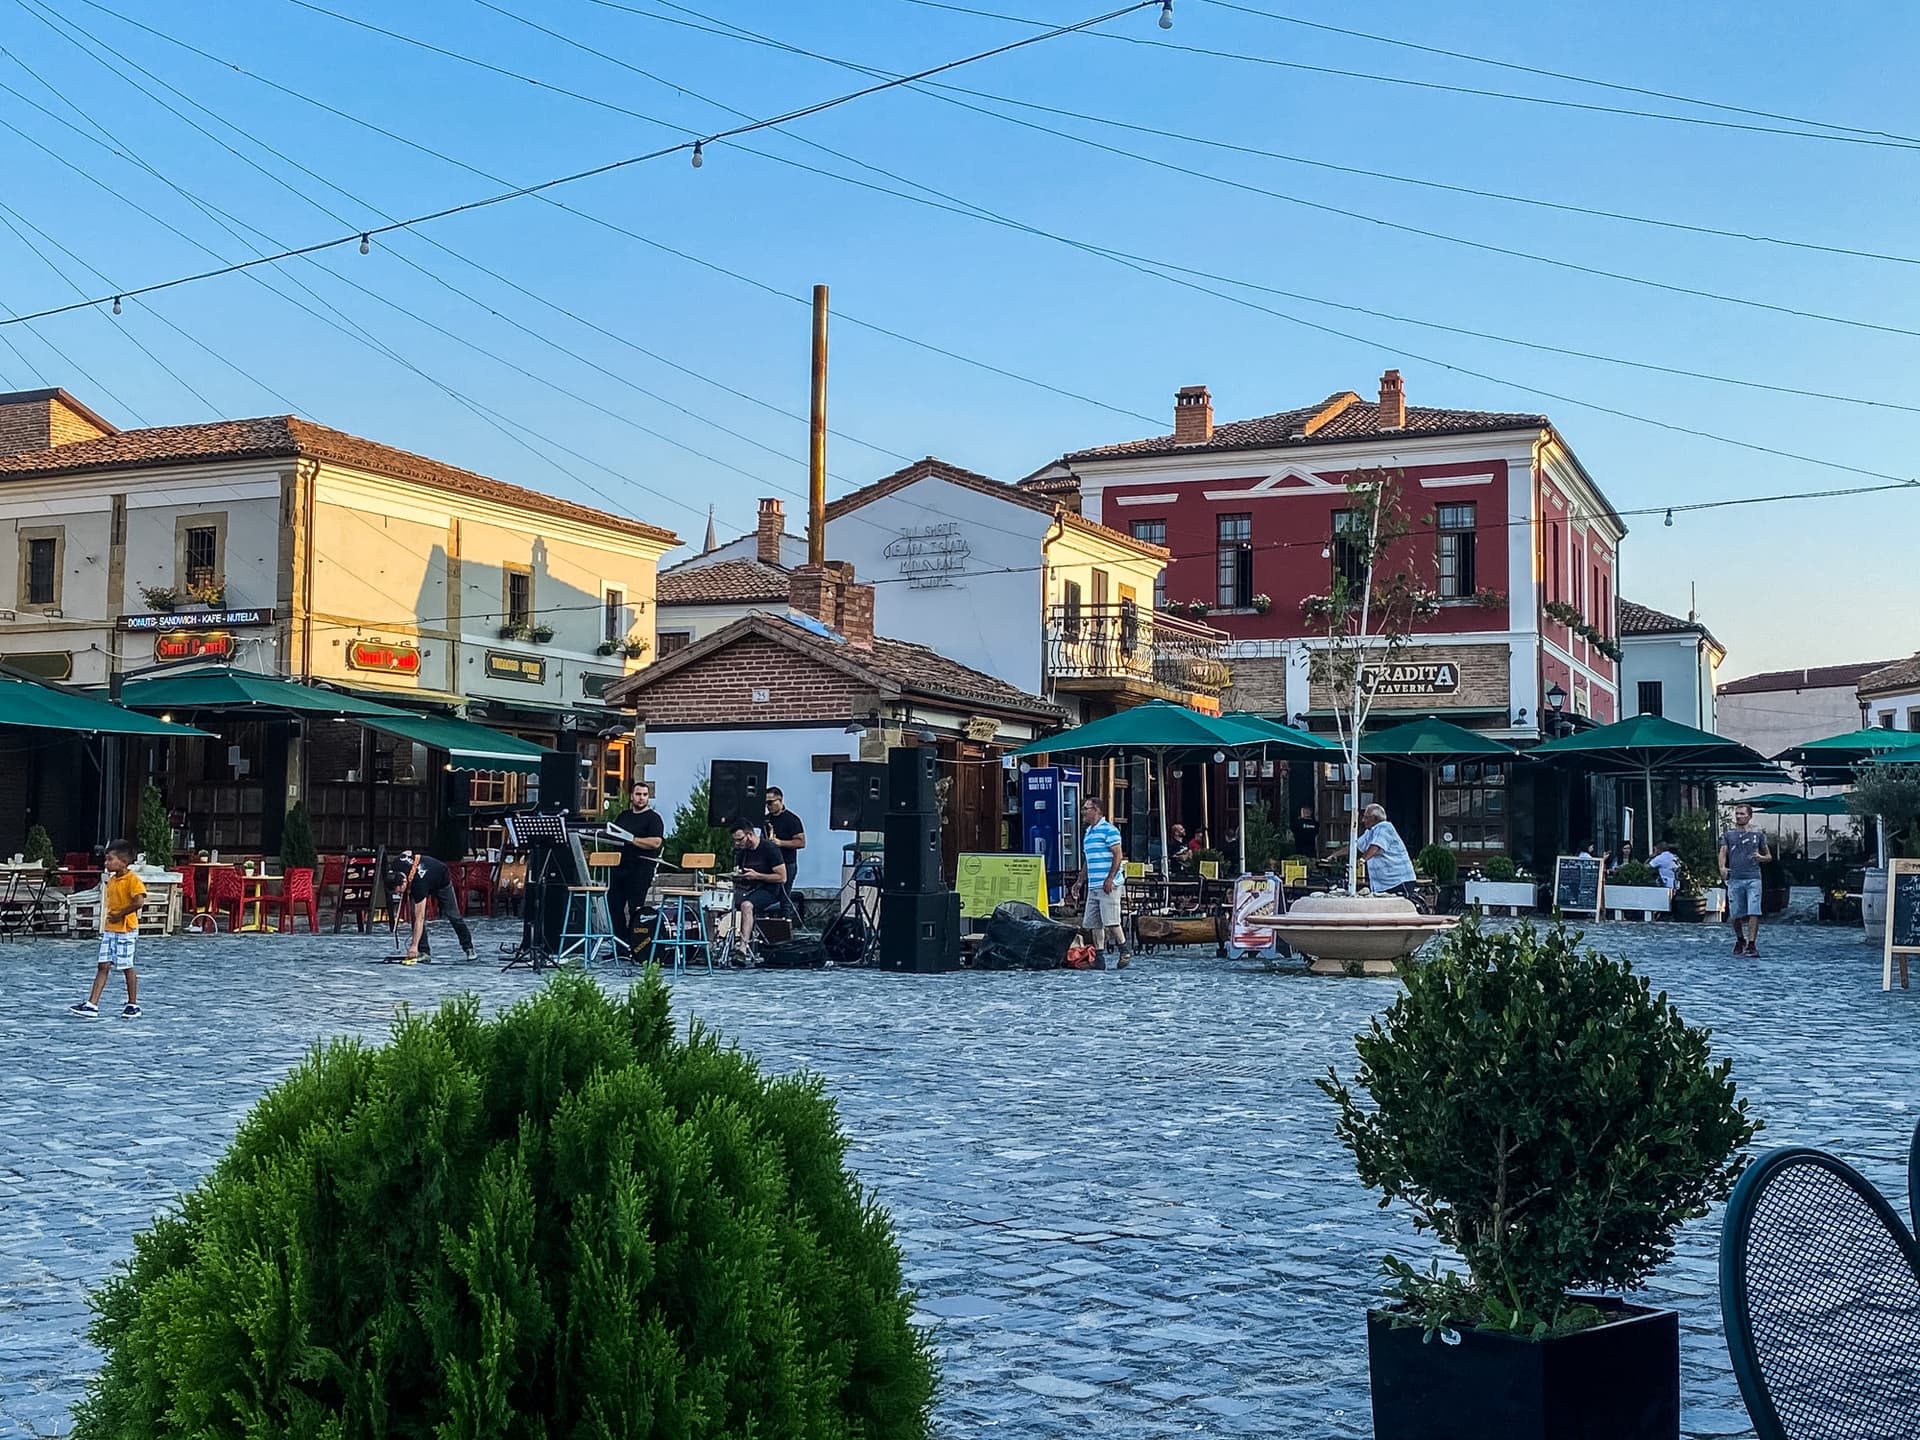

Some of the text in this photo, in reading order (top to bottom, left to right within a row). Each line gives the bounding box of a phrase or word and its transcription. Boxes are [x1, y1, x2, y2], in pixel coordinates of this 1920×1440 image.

[159, 615, 197, 626] SANDWICH
[202, 613, 222, 624] KAFE
[227, 611, 259, 623] NUTELLA
[1363, 665, 1455, 687] TRADITA
[1378, 684, 1434, 693] TAVERNA
